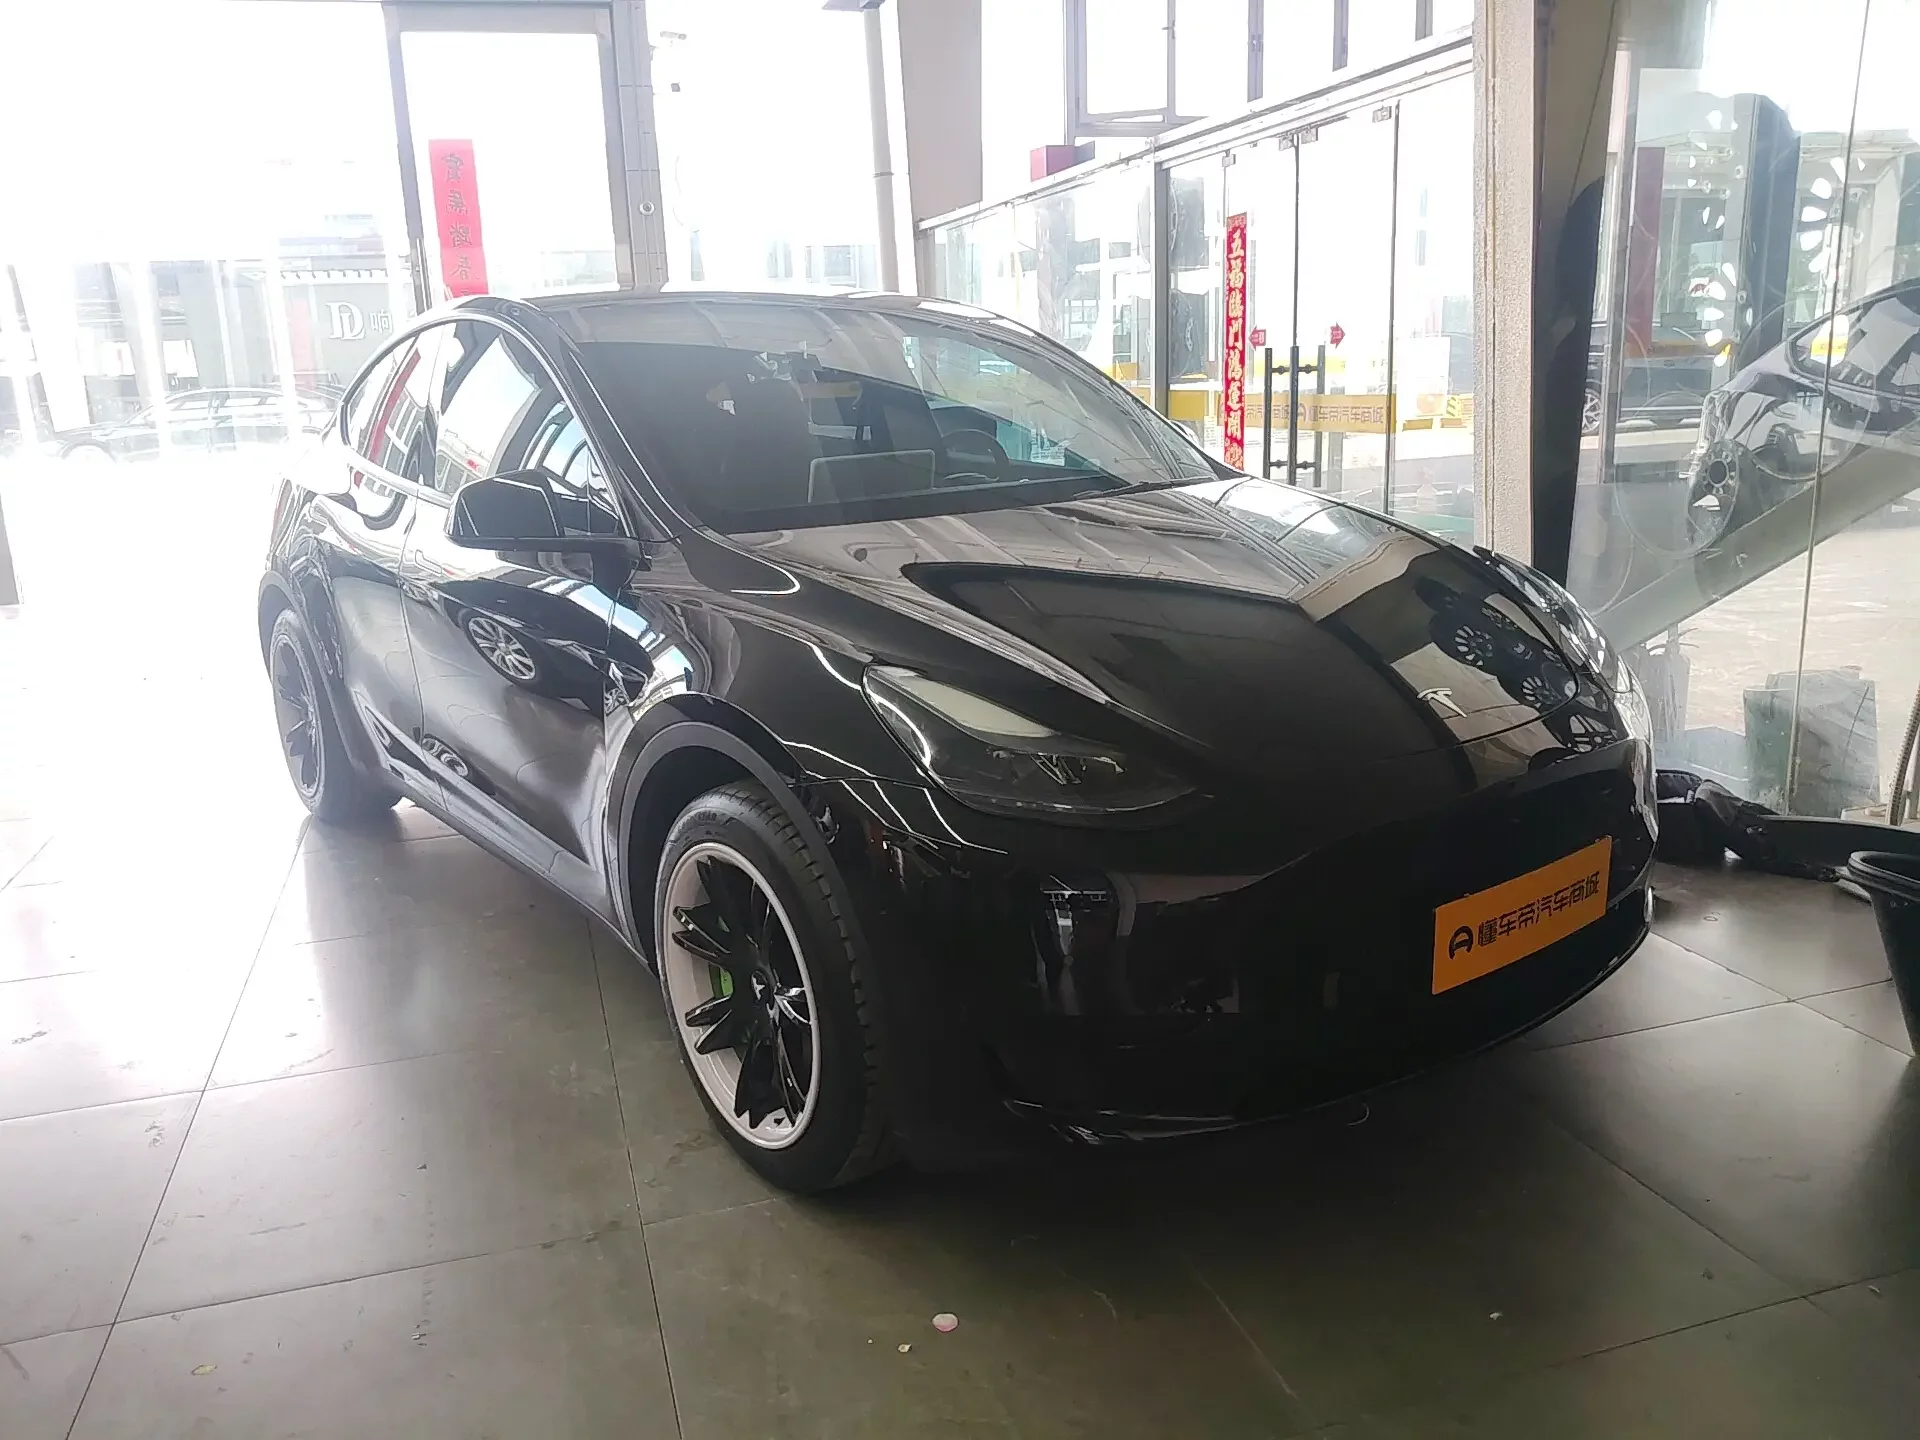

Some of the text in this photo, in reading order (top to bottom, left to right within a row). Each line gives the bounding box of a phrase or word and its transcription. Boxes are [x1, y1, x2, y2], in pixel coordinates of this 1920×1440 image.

[1477, 871, 1600, 947] 懂车帝汽车商城
